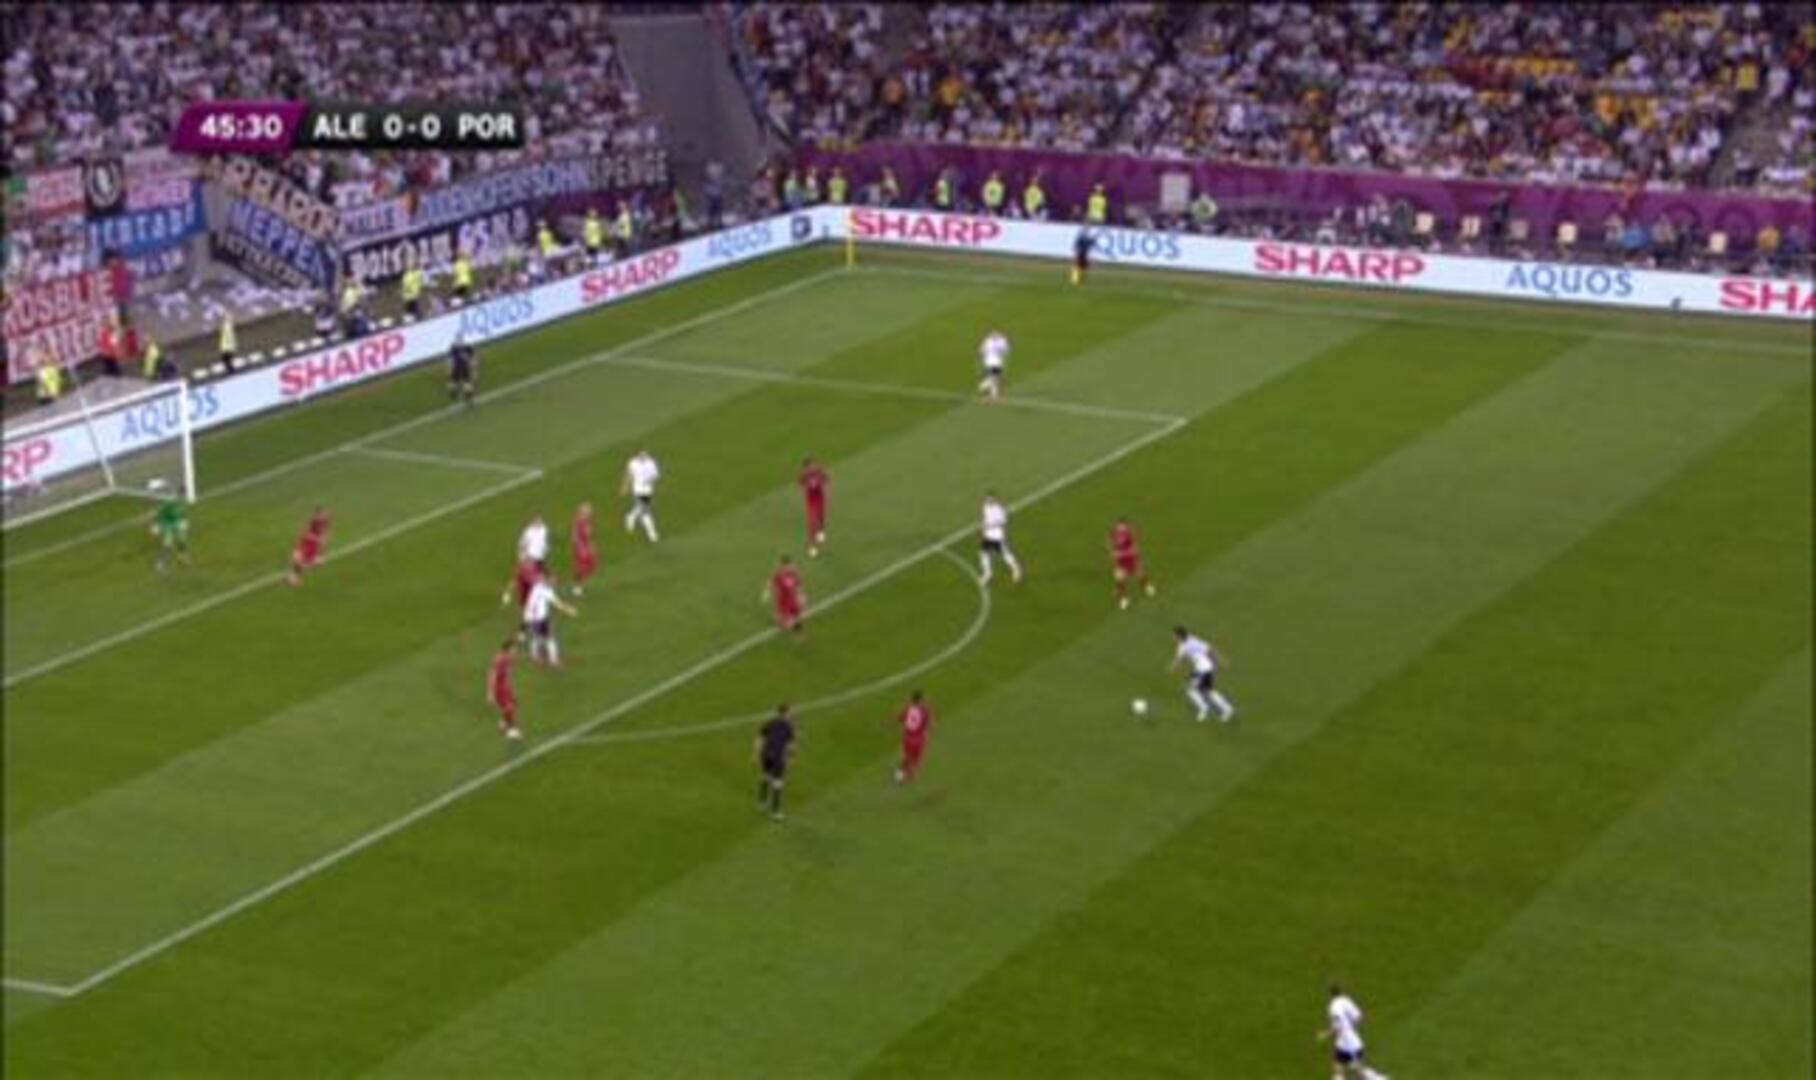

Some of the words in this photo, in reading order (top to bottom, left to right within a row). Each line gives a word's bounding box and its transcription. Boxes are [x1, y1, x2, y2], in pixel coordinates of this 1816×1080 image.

[849, 208, 1001, 246] SHARP
[580, 247, 681, 305] SHARP
[1253, 243, 1426, 283] SHARP
[1506, 263, 1635, 298] AQUOS
[459, 294, 535, 338] AQUOS
[277, 331, 407, 397] SHARP
